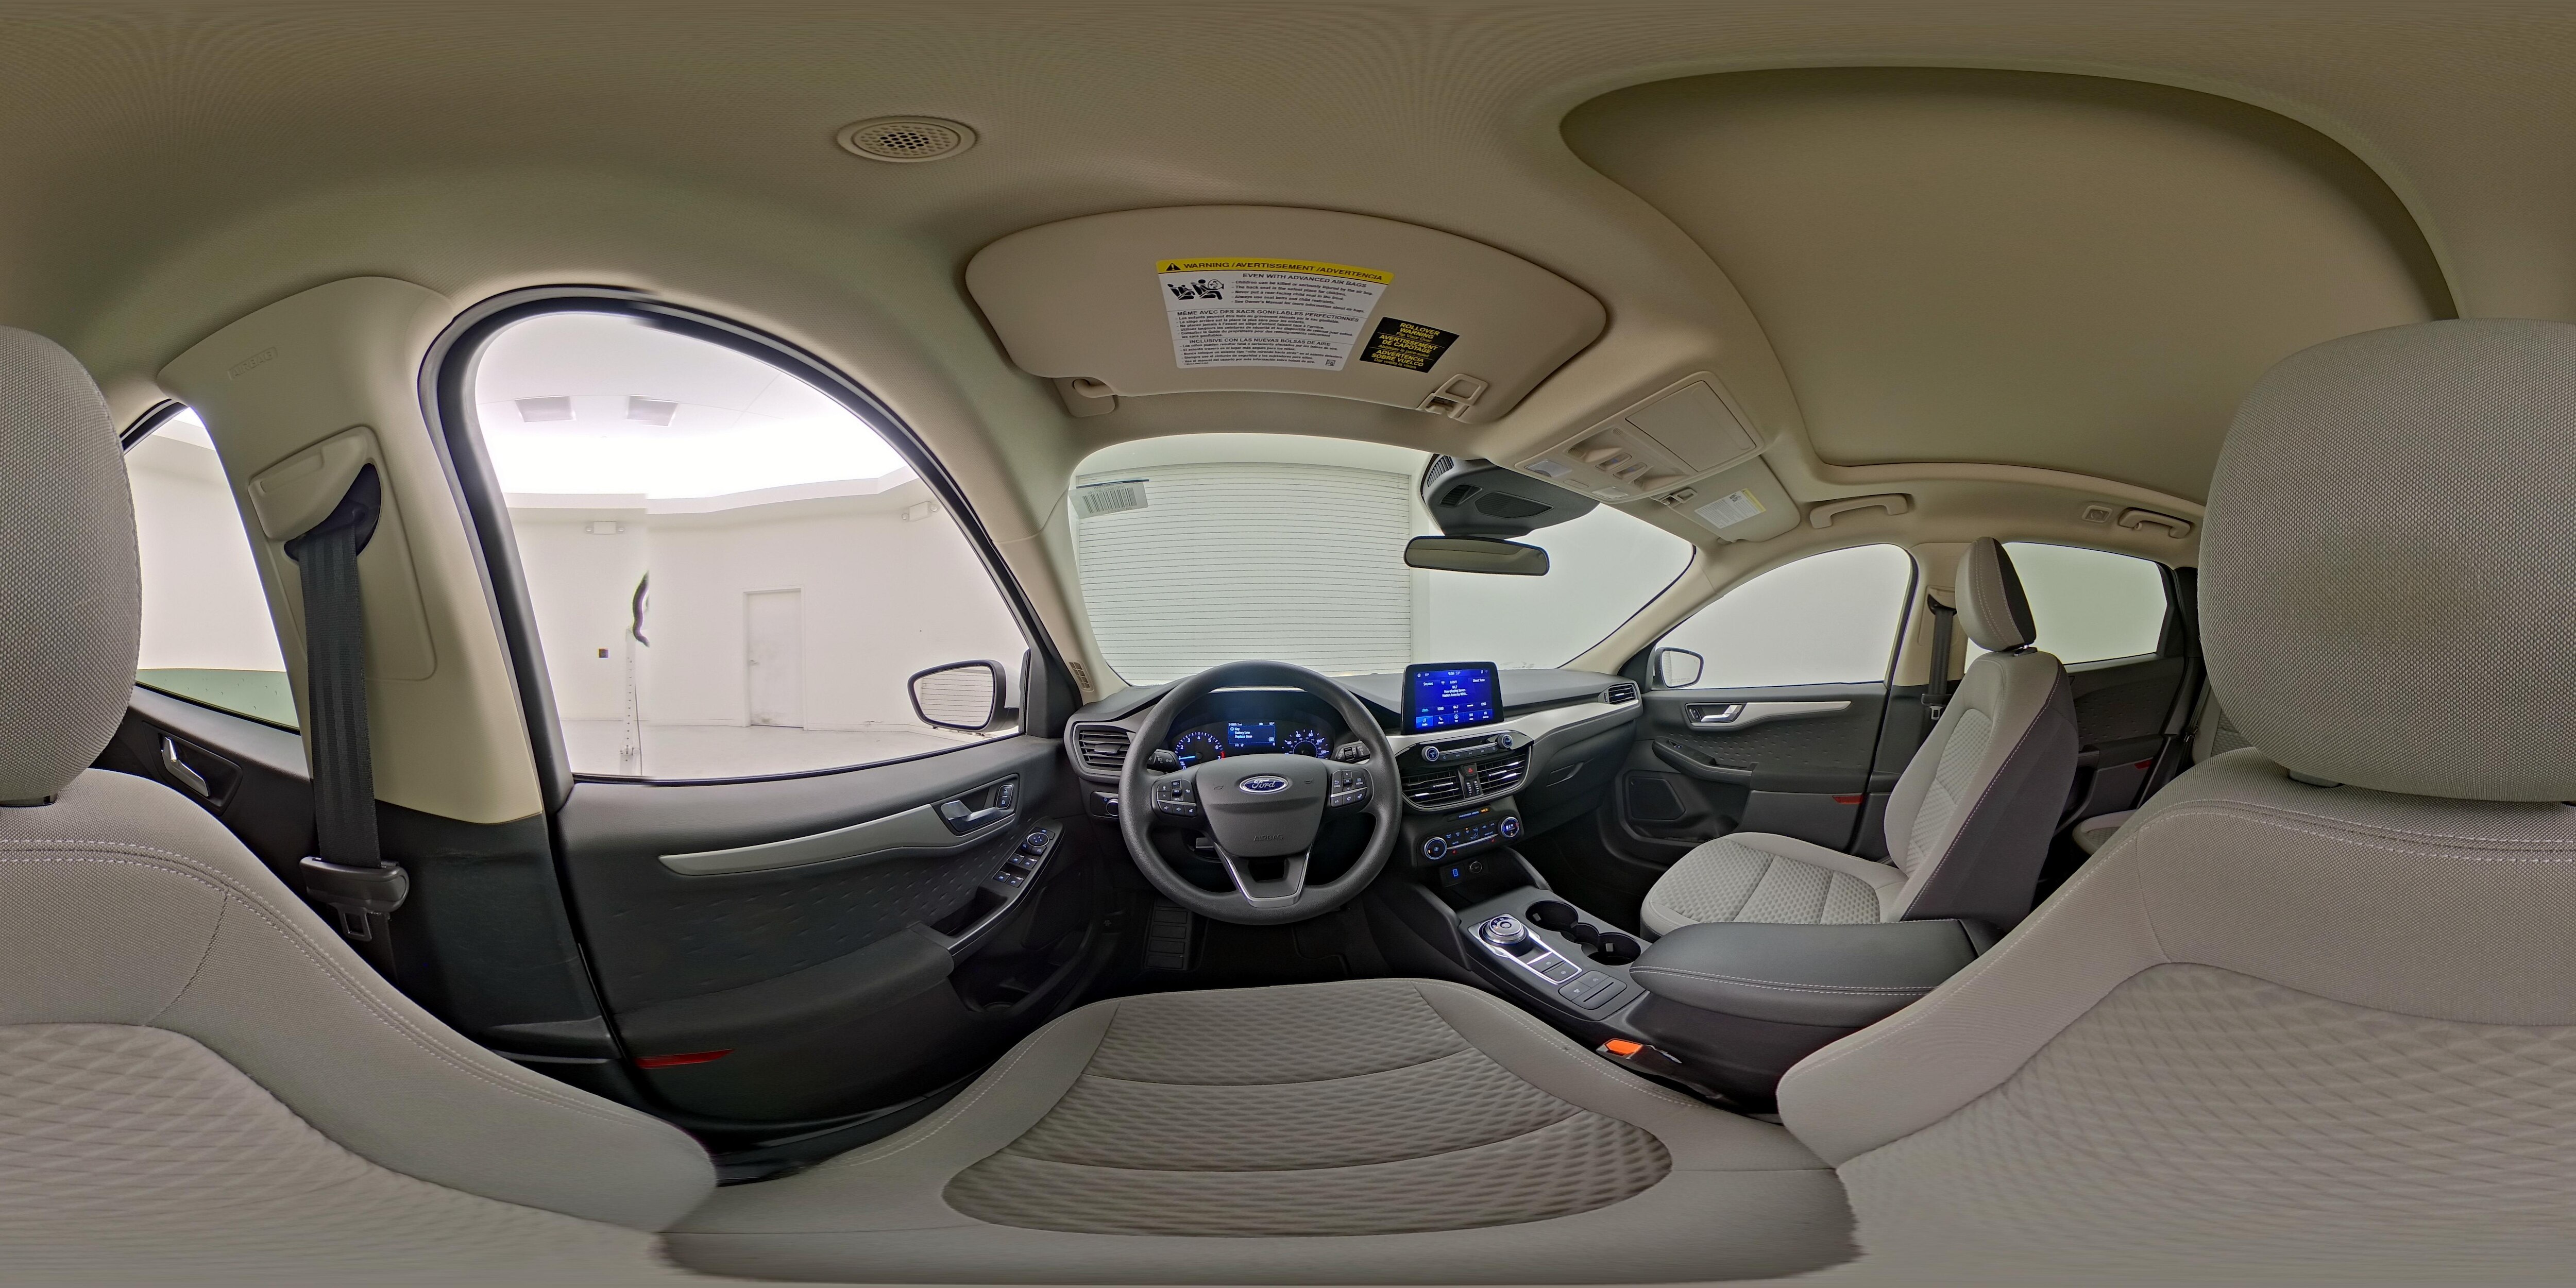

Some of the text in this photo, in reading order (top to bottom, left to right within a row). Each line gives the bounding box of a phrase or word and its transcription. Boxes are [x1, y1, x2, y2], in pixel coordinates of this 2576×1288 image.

[1231, 262, 1315, 270] /AVERTISSEMENT
[1316, 266, 1383, 280] /ADVERTENCIA
[1304, 311, 1360, 321] PERFECTIONNÉS
[1399, 323, 1440, 336] ROLLOVER
[1399, 327, 1434, 339] WARNING
[1379, 334, 1438, 350] AVERTISSEMENT
[1393, 341, 1432, 354] CAPOTAGE
[1371, 353, 1424, 367] SOBRE VUELCO
[1376, 349, 1424, 363] ADVERTENCIA
[232, 351, 273, 379] AIRBAG
[1251, 779, 1276, 789] Ford
[1253, 834, 1283, 842] AIRBAG
